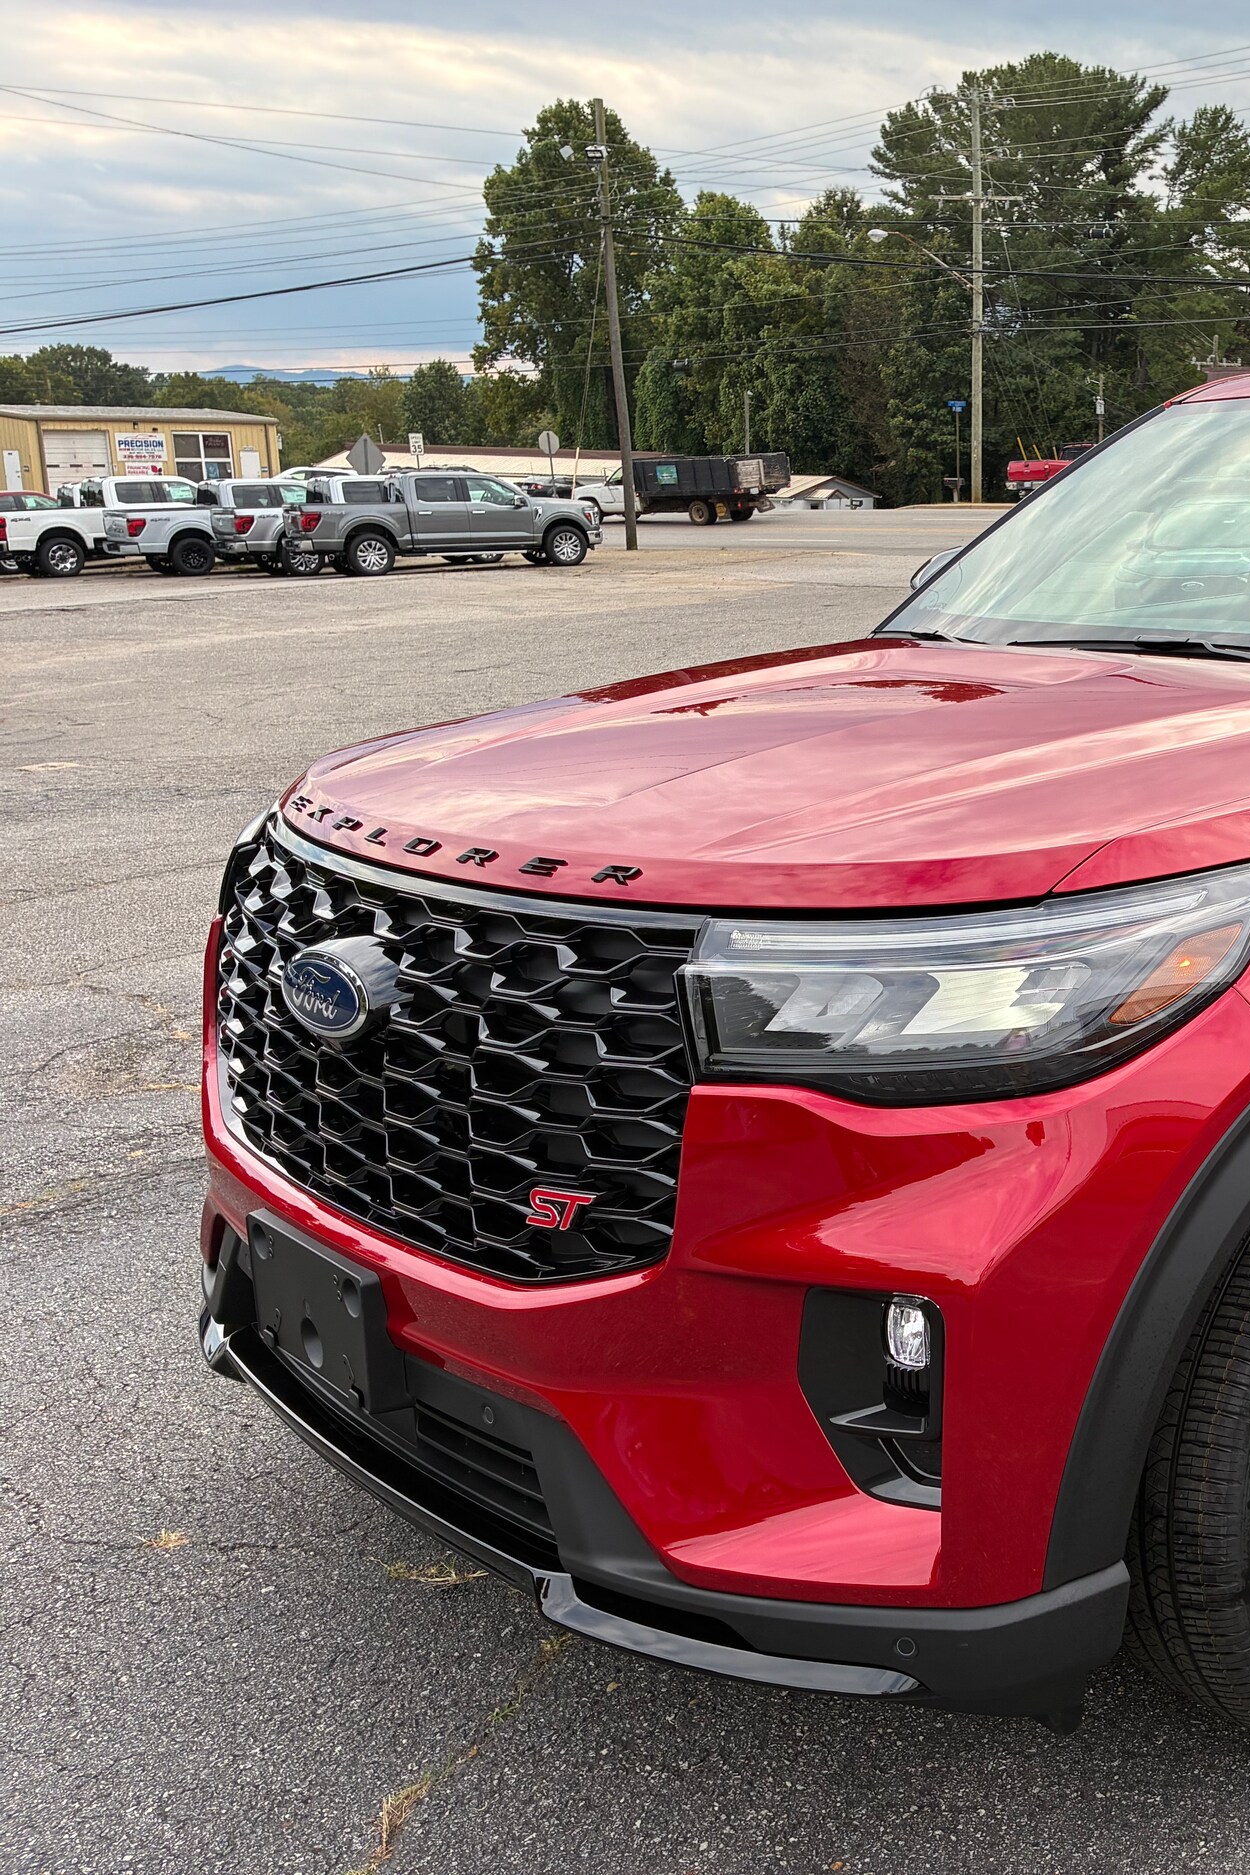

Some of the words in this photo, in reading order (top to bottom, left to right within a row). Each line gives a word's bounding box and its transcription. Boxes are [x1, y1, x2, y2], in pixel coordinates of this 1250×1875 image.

[118, 440, 164, 448] PRECISION
[412, 444, 422, 453] 35
[289, 795, 644, 887] EXPLORER
[292, 966, 341, 1019] Ford
[526, 1186, 597, 1230] ST
